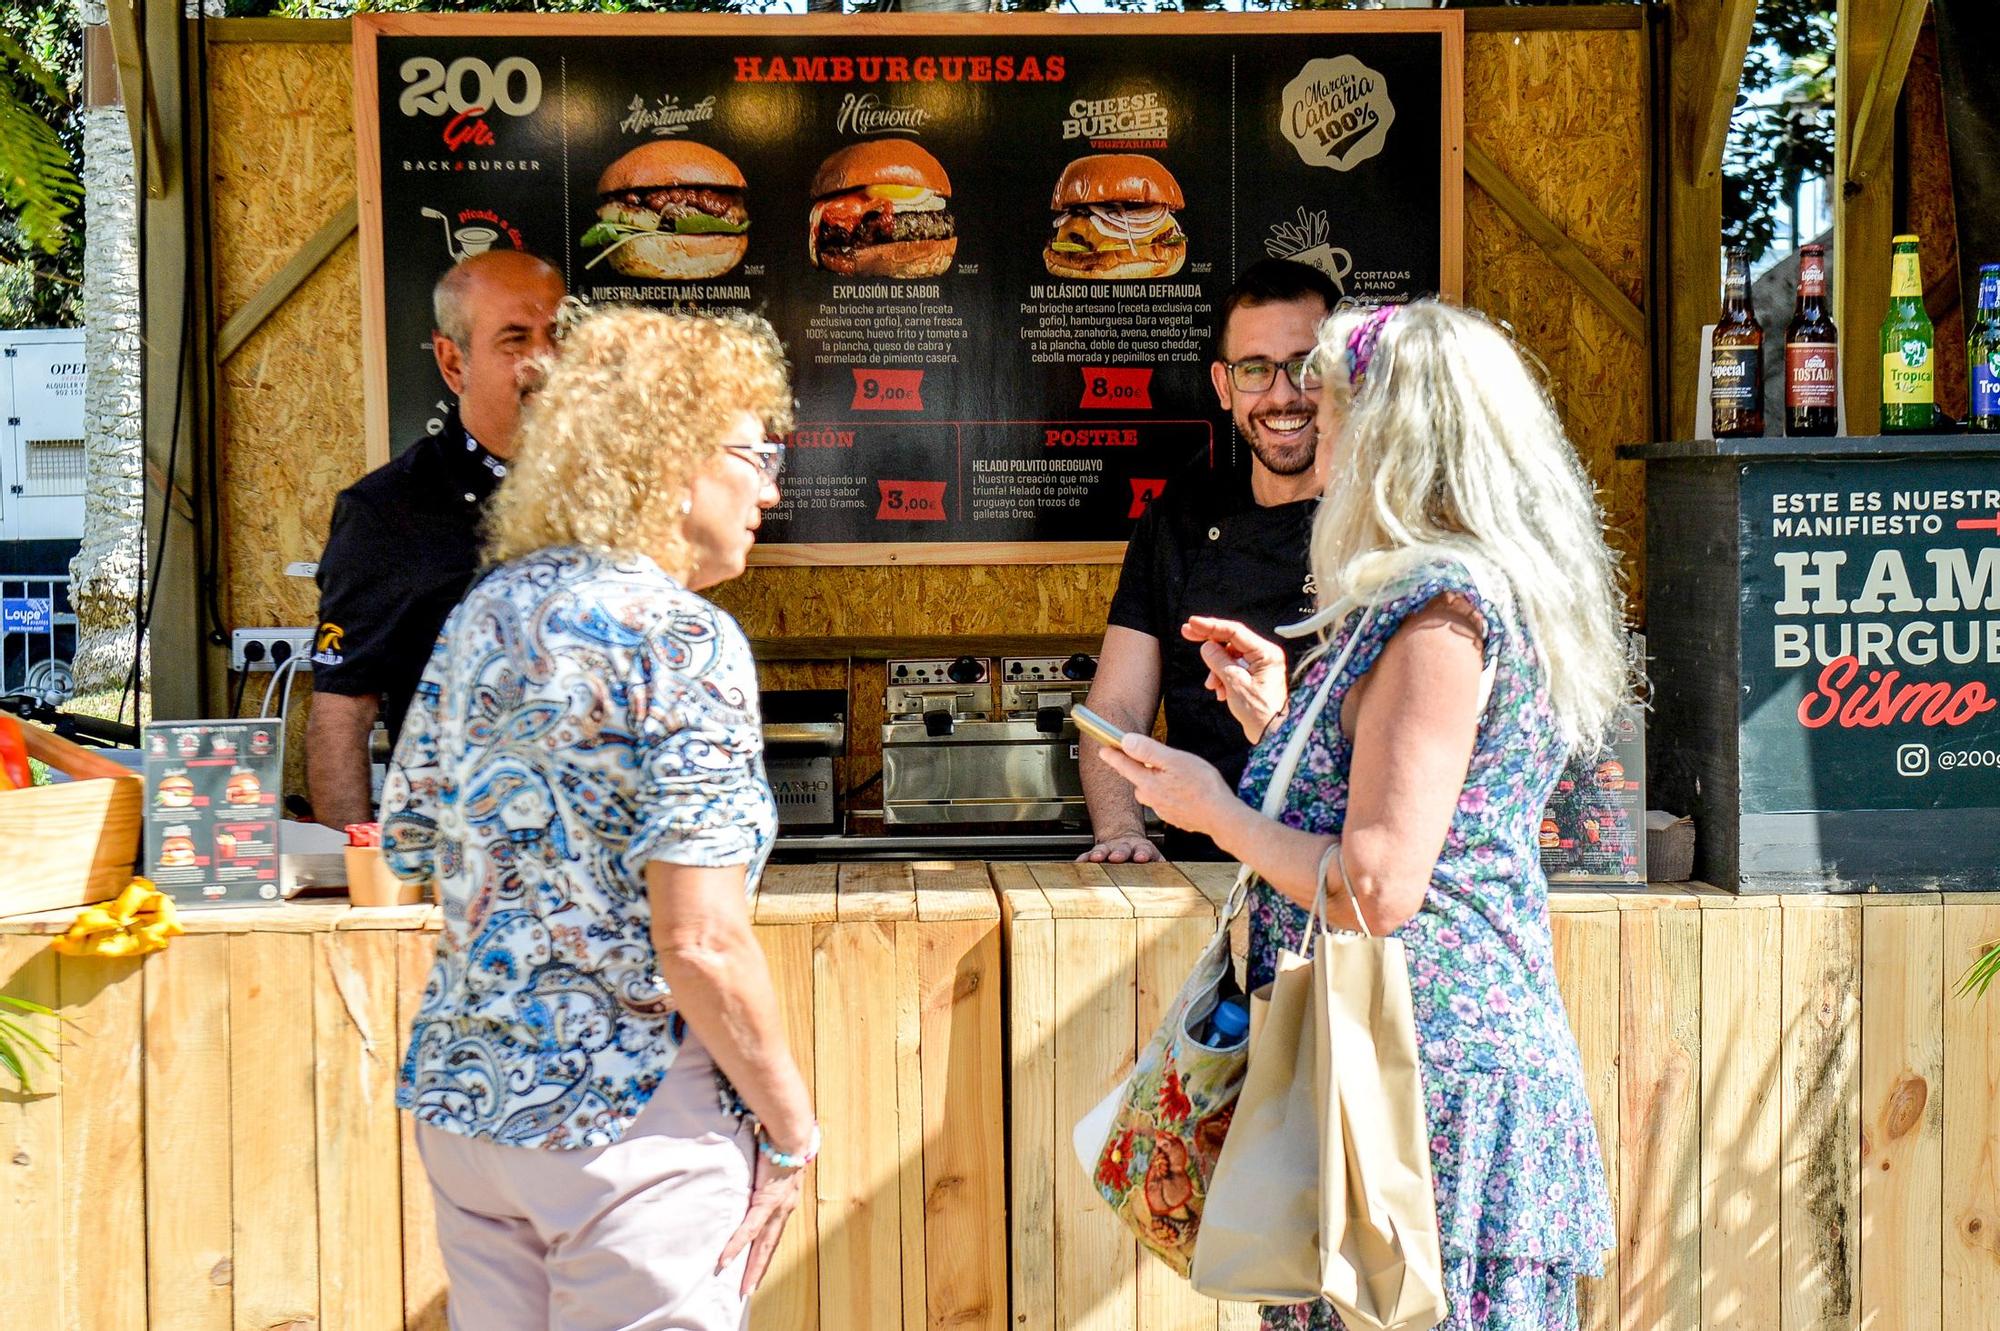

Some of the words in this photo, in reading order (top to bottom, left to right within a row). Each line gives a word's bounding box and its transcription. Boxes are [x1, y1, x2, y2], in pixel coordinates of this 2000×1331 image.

[735, 56, 1065, 82] HAMBURGUESAS
[400, 56, 542, 117] 200
[1304, 74, 1352, 107] Marca
[1069, 93, 1158, 118] CHEESE
[1292, 75, 1374, 139] Canaria
[620, 96, 716, 134] Afortunada
[837, 93, 925, 134] Huevona
[1063, 107, 1168, 139] BURGER
[1313, 102, 1377, 147] 100%
[1090, 140, 1168, 149] VEGETARIANA
[403, 161, 450, 171] BACK
[468, 160, 540, 171] BURGER
[1354, 271, 1411, 280] CORTADAS
[592, 286, 638, 300] NUESTRA
[640, 286, 678, 300] RECETA
[681, 283, 704, 300] MÁS
[706, 286, 751, 299] CANARIA
[833, 283, 888, 299] EXPLOSIÓN
[890, 285, 904, 298] DE
[906, 285, 940, 298] SABOR
[1030, 285, 1044, 299] UN
[1046, 283, 1088, 298] CLÁSICO
[1090, 285, 1110, 299] QUE
[1112, 285, 1147, 298] NUNCA
[1149, 284, 1201, 298] DEFRAUDA
[1354, 281, 1361, 289] A
[1364, 281, 1396, 289] MANO
[819, 304, 837, 315] Pan
[839, 304, 873, 315] brioche
[876, 305, 917, 315] artesano
[1020, 303, 1038, 314] Pan
[1039, 303, 1073, 314] brioche
[1075, 304, 1116, 314] artesano
[1152, 302, 1193, 313] exclusiva
[1194, 304, 1212, 313] con
[810, 316, 852, 327] exclusiva
[854, 318, 871, 327] con
[904, 318, 931, 327] carne
[933, 316, 963, 327] fresca
[1070, 315, 1133, 327] hamburguesa
[1159, 315, 1193, 327] vegetal
[805, 328, 828, 339] 100%
[829, 330, 865, 340] vacuno,
[867, 328, 894, 339] huevo
[896, 328, 917, 339] frito
[918, 331, 925, 341] y
[926, 329, 960, 339] tomate
[962, 331, 968, 339] a
[1074, 327, 1119, 339] zanahoria,
[1120, 329, 1149, 339] avena,
[1150, 327, 1180, 338] eneldo
[1181, 330, 1188, 340] y
[822, 341, 831, 351] la
[833, 341, 871, 353] plancha,
[873, 342, 901, 354] queso
[903, 341, 915, 351] de
[917, 340, 944, 351] cabra
[945, 343, 952, 353] y
[1030, 342, 1037, 350] a
[1039, 340, 1048, 350] la
[1050, 340, 1088, 351] plancha,
[1090, 340, 1115, 350] doble
[1117, 340, 1129, 350] de
[1131, 342, 1159, 352] queso
[1161, 339, 1201, 351] cheddar,
[815, 353, 867, 364] mermelada
[869, 353, 881, 364] de
[883, 353, 923, 365] pimiento
[925, 354, 960, 364] casera.
[1031, 352, 1065, 363] cebolla
[1067, 352, 1102, 362] morada
[1104, 354, 1110, 364] y
[1112, 352, 1156, 364] pepinillos
[1157, 353, 1169, 362] en
[1171, 351, 1201, 362] crudo.
[1793, 368, 1834, 381] TOSTADA
[1891, 368, 1933, 383] Tropical
[787, 427, 856, 448] ICIÓN
[1045, 429, 1138, 447] POSTRE
[972, 459, 1009, 472] HELADO
[1010, 459, 1047, 472] POLVITO
[1049, 459, 1103, 472] OREOGUAYO
[788, 477, 813, 485] mano
[816, 475, 853, 486] dejando
[855, 477, 867, 485] un
[978, 475, 1014, 484] Nuestra
[1017, 473, 1057, 483] creación
[1059, 475, 1077, 485] que
[1079, 474, 1099, 484] más
[814, 488, 831, 496] ese
[833, 486, 860, 497] sabor
[973, 485, 1007, 496] triunfa!
[1009, 485, 1041, 496] Helado
[1043, 485, 1055, 495] de
[1057, 485, 1088, 497] polvito
[797, 499, 809, 509] de
[811, 499, 828, 509] 200
[829, 499, 868, 509] Gramos.
[973, 499, 1016, 509] uruguayo
[1018, 498, 1035, 507] con
[1037, 497, 1066, 507] trozos
[1068, 497, 1080, 507] de
[1773, 493, 1839, 514] ESTE
[1850, 492, 1882, 512] ES
[1893, 489, 2000, 510] NUESTR
[973, 509, 1010, 521] galletas
[1012, 509, 1037, 519] Oreo.
[1773, 514, 1943, 537] MANIFIESTO
[1773, 547, 2000, 615] HAM
[1796, 655, 1997, 729] Sismo
